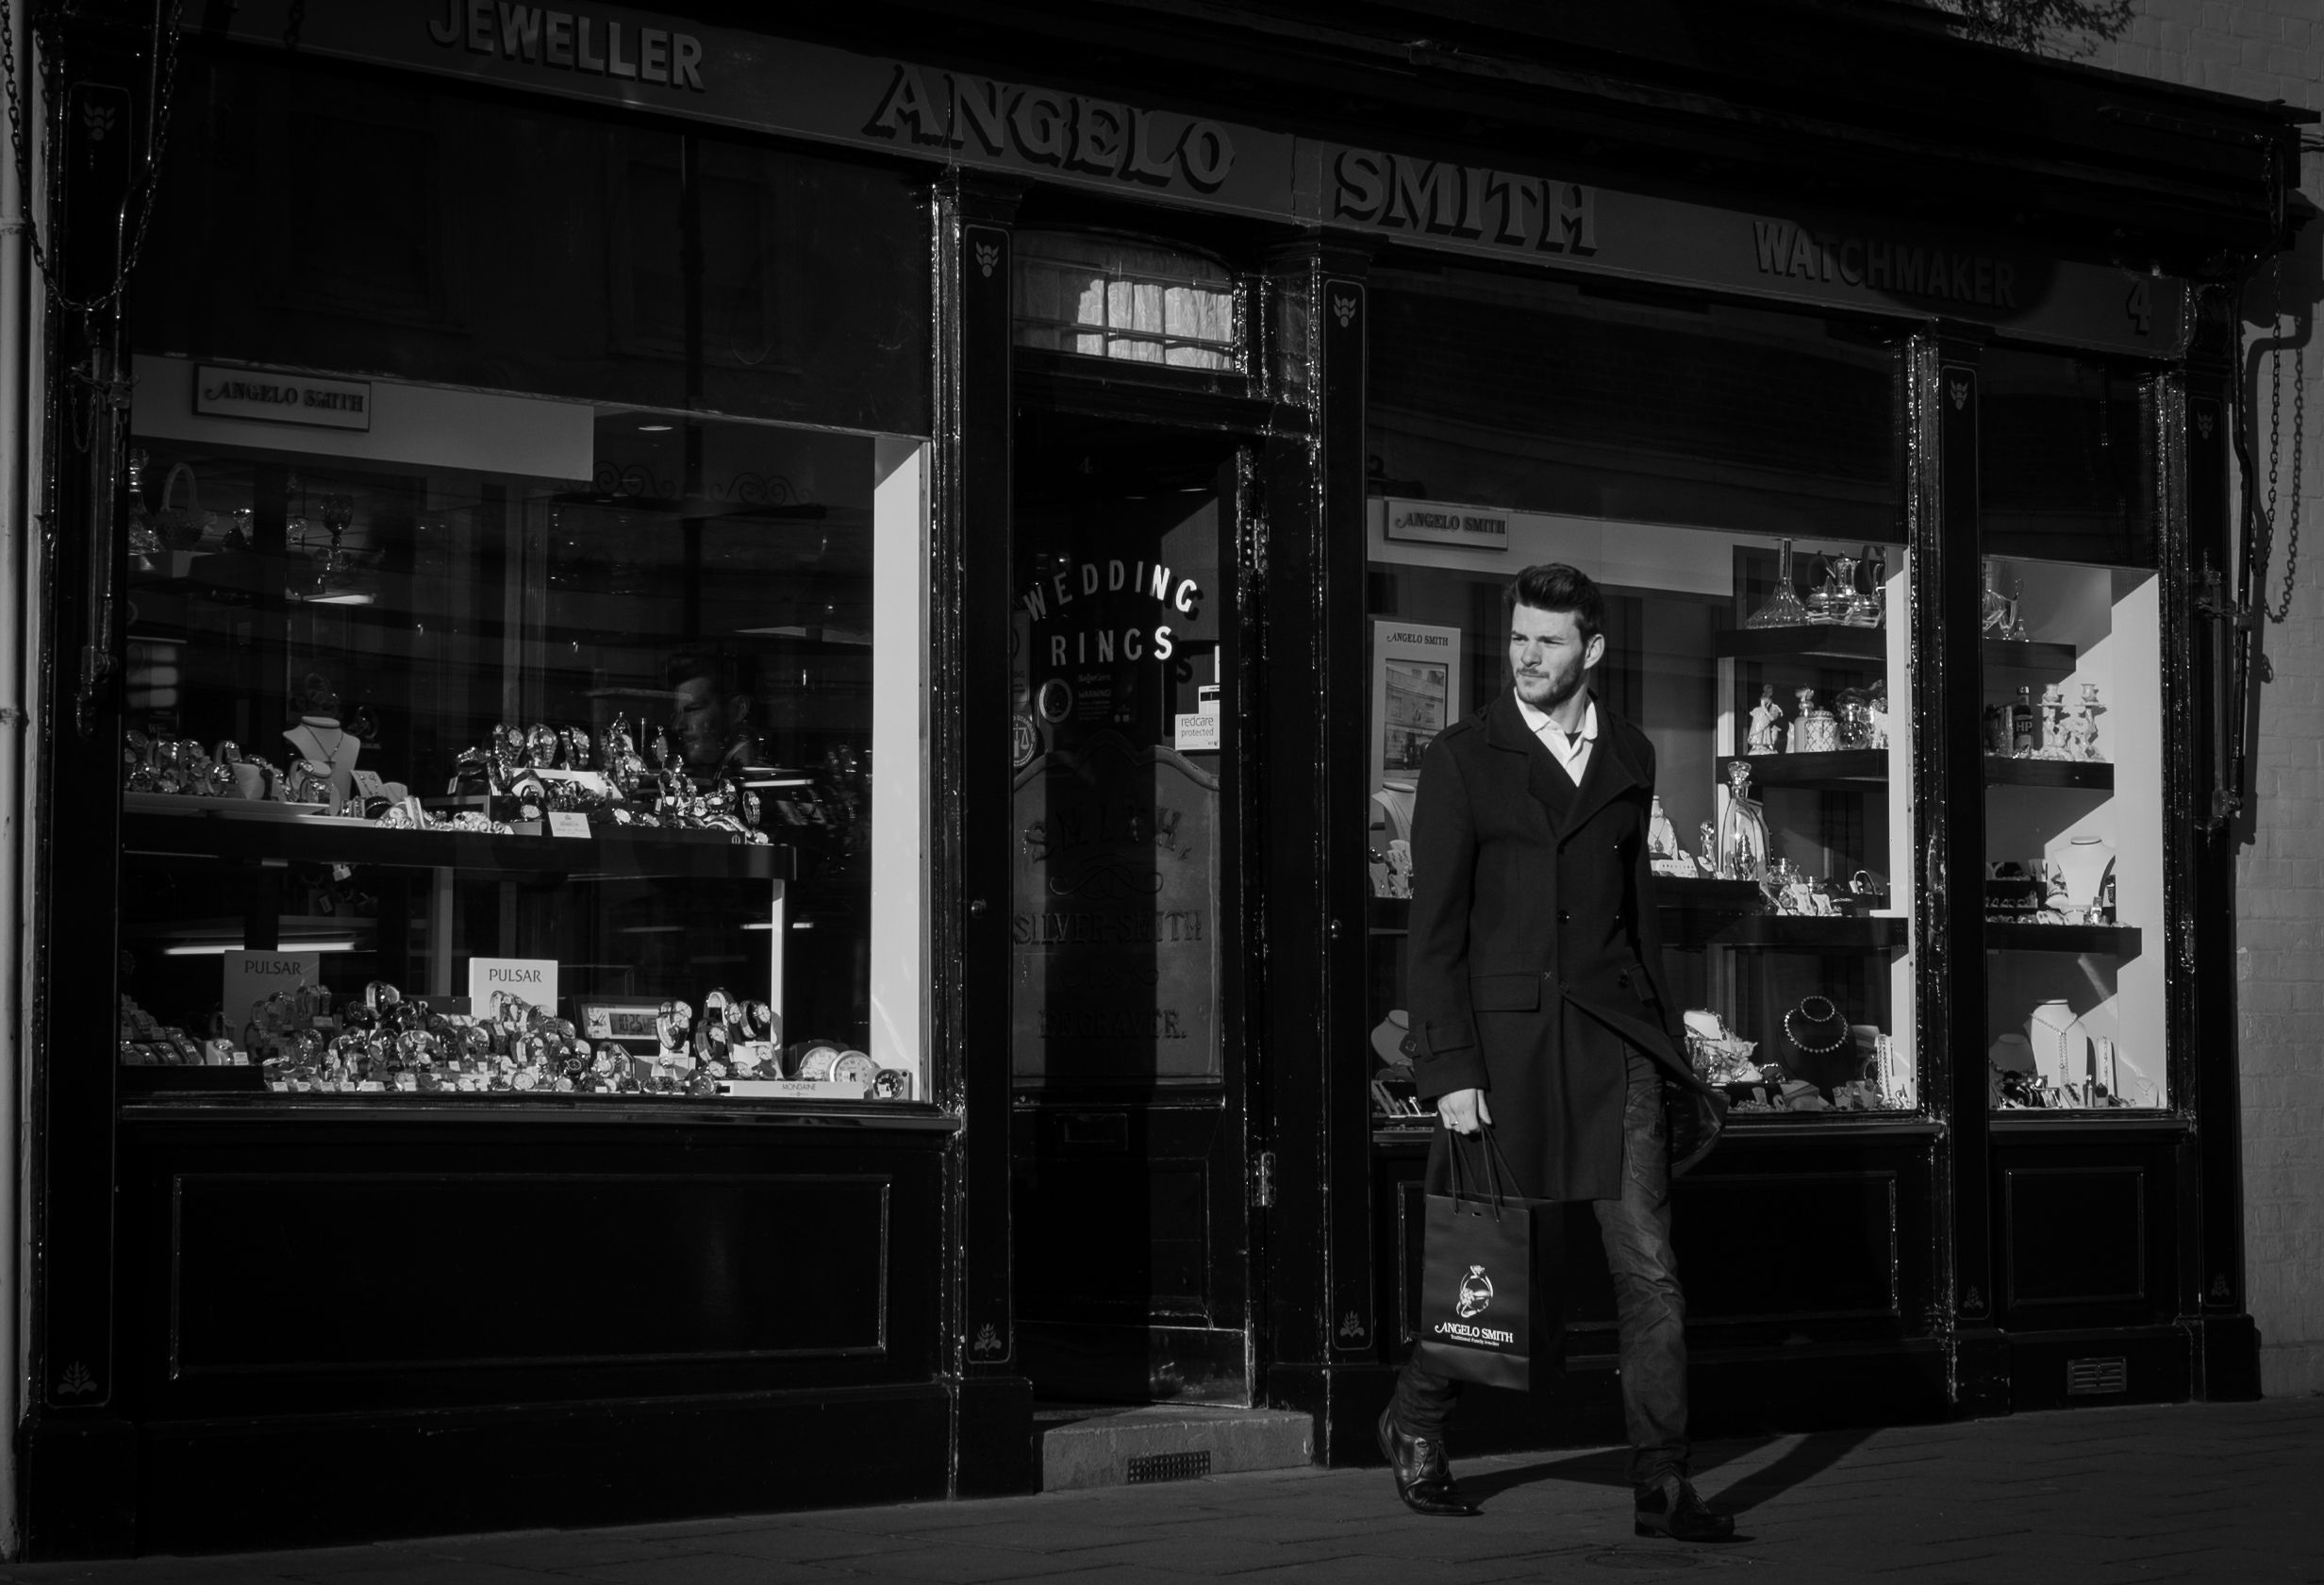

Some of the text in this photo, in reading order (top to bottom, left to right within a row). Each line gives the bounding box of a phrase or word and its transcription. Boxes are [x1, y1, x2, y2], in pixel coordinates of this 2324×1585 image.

[428, 0, 706, 92] JEWELLER
[864, 64, 1598, 256] ANGELO SMITH
[1753, 220, 2017, 309] WATCHMAKER
[2126, 279, 2152, 336] 4
[205, 381, 364, 412] ANGELO SMITH
[1396, 512, 1506, 534] ANGELO SMITH
[1022, 559, 1197, 622] WEDDING
[1051, 626, 1172, 666] RINGS
[1386, 632, 1449, 647] ANGELO SMITH
[1181, 715, 1214, 727] redcare
[2016, 721, 2033, 732] HP
[1181, 727, 1214, 739] protected
[244, 959, 302, 976] PULSAR
[489, 968, 542, 983] PULSAR
[1435, 1322, 1514, 1343] ANGELO SMITH
